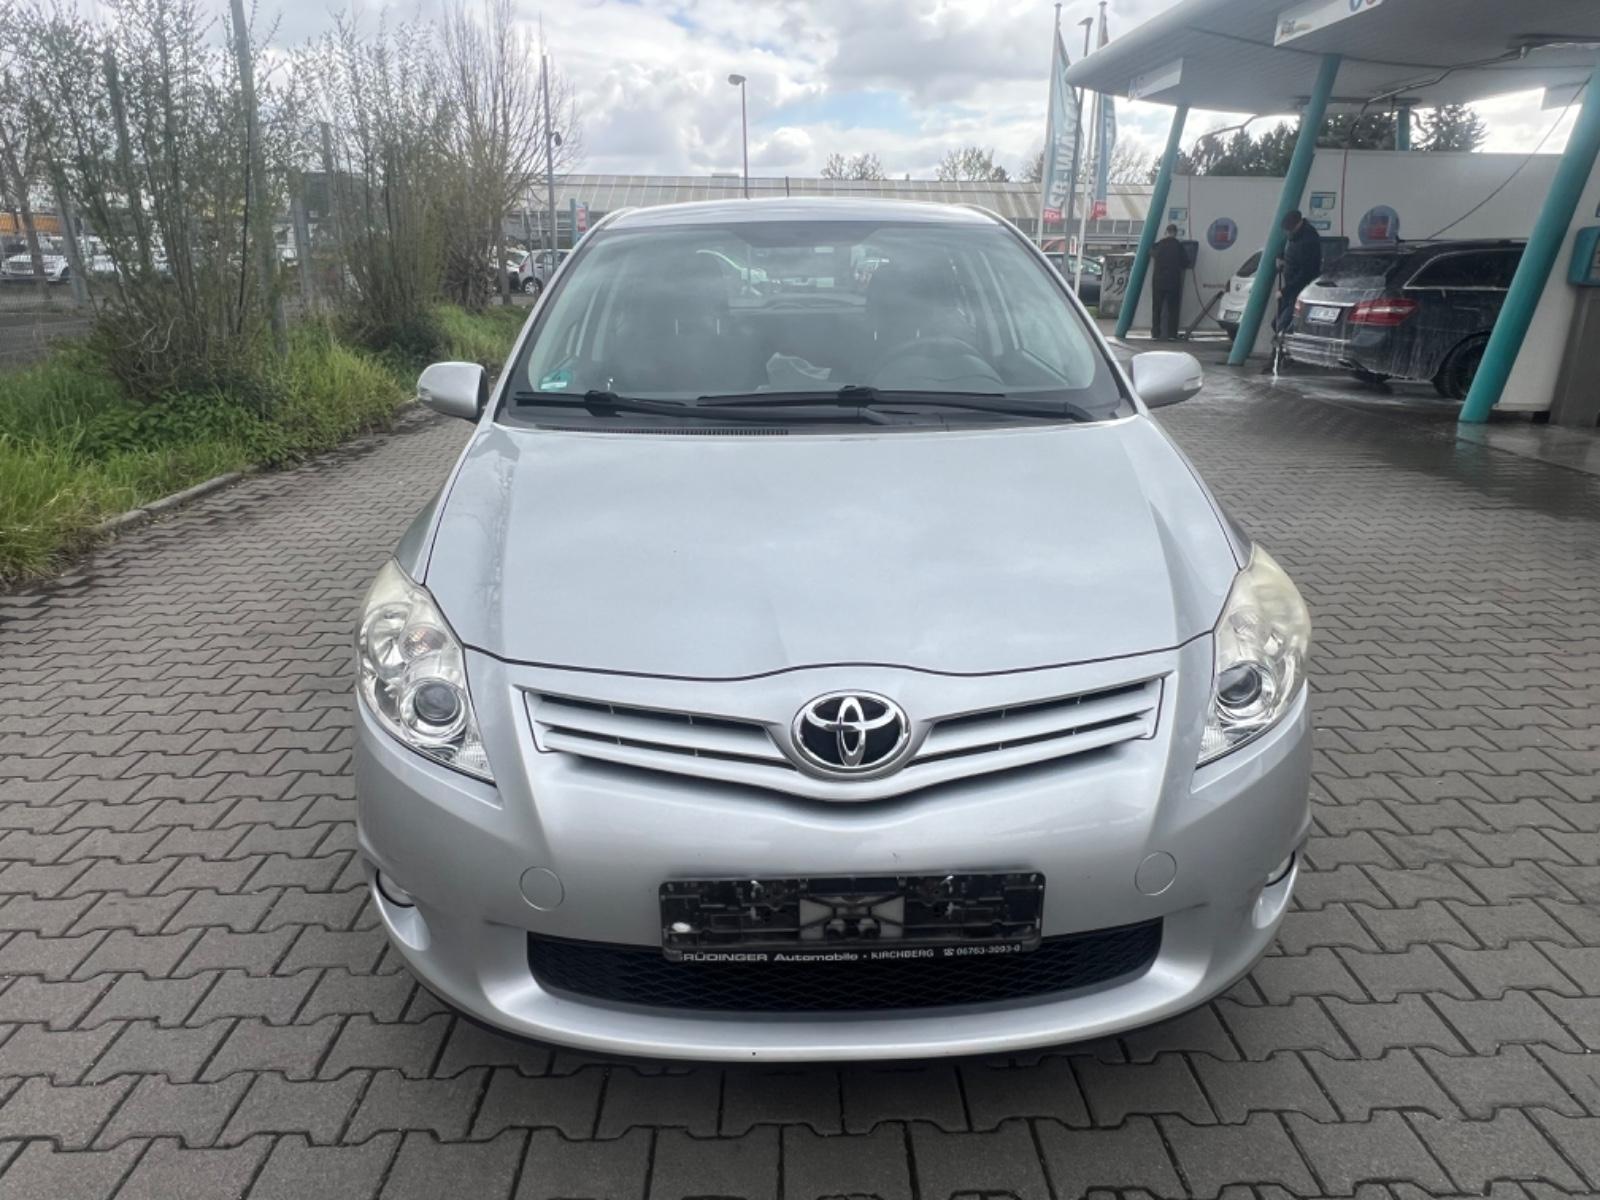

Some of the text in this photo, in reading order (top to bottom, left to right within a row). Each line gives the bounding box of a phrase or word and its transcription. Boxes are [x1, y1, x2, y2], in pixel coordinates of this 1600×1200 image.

[683, 951, 768, 962] RÜDINGER
[774, 952, 858, 961] Automobile
[870, 949, 934, 960] KIRCHBERG
